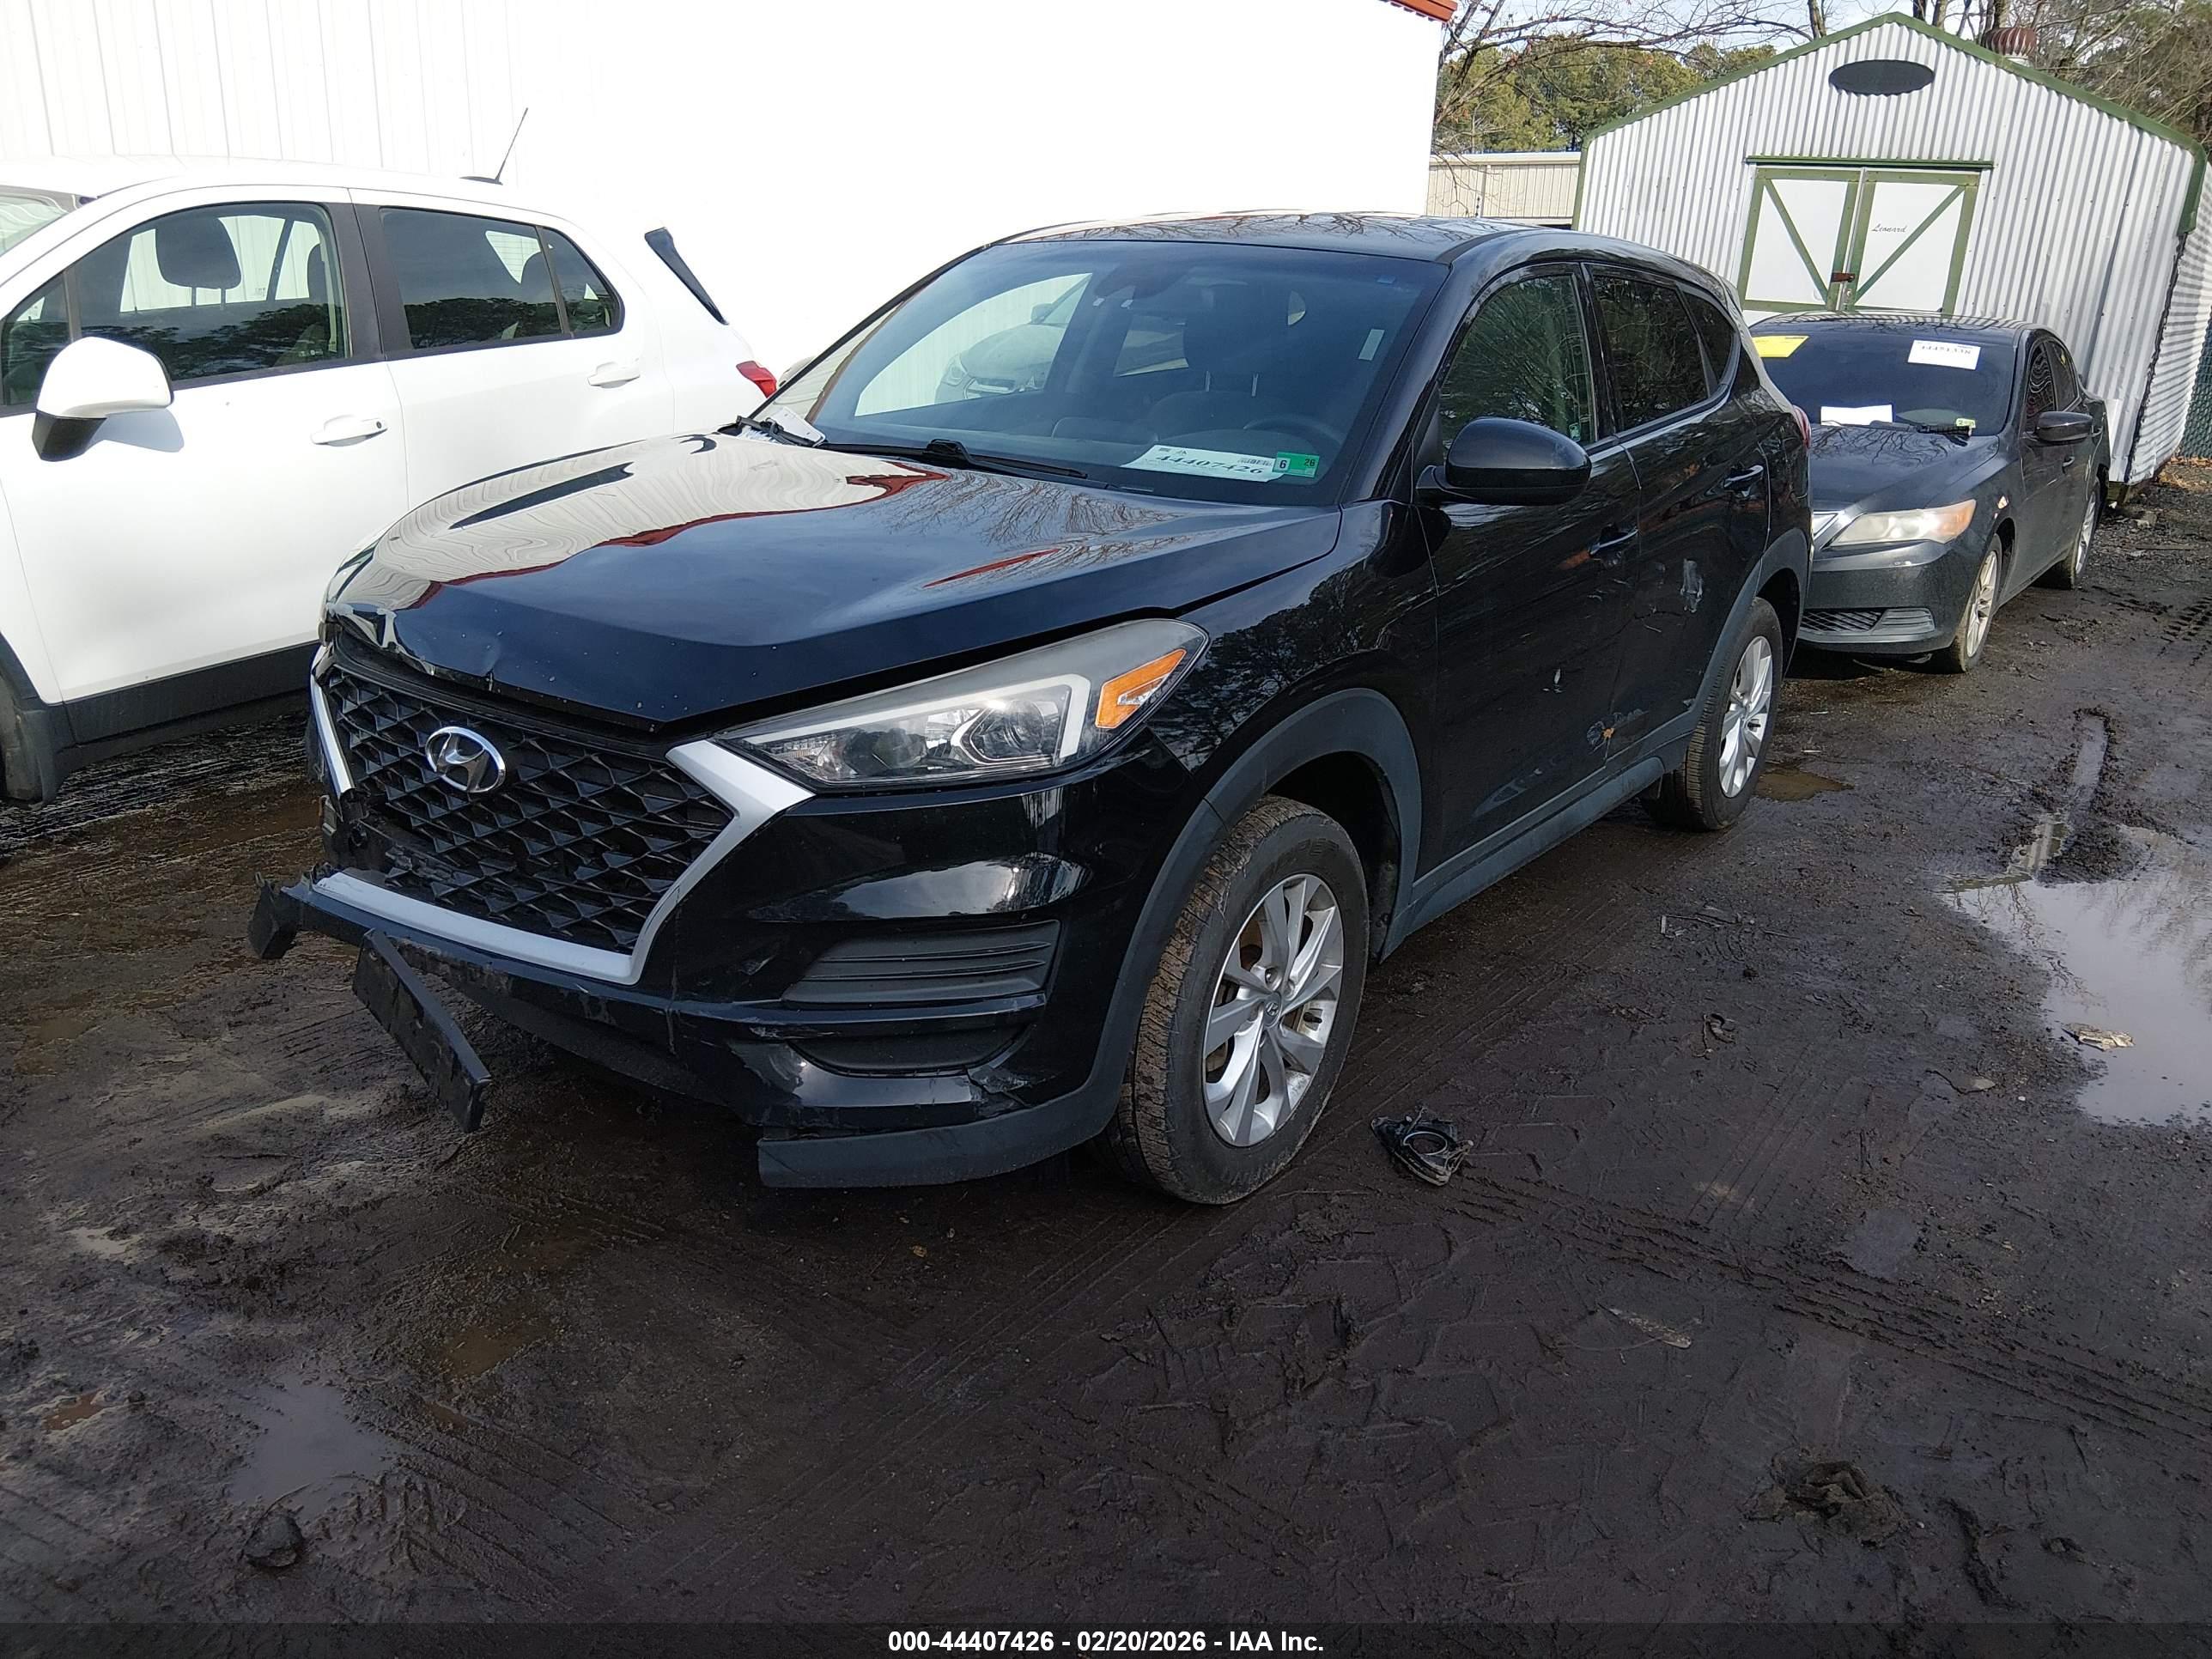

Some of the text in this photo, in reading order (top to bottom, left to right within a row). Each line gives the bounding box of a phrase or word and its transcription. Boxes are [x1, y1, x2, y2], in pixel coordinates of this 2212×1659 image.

[1870, 223, 1907, 234] Leonard
[1155, 455, 1265, 475] 44407426
[1279, 459, 1288, 469] 6
[1304, 458, 1316, 467] 26
